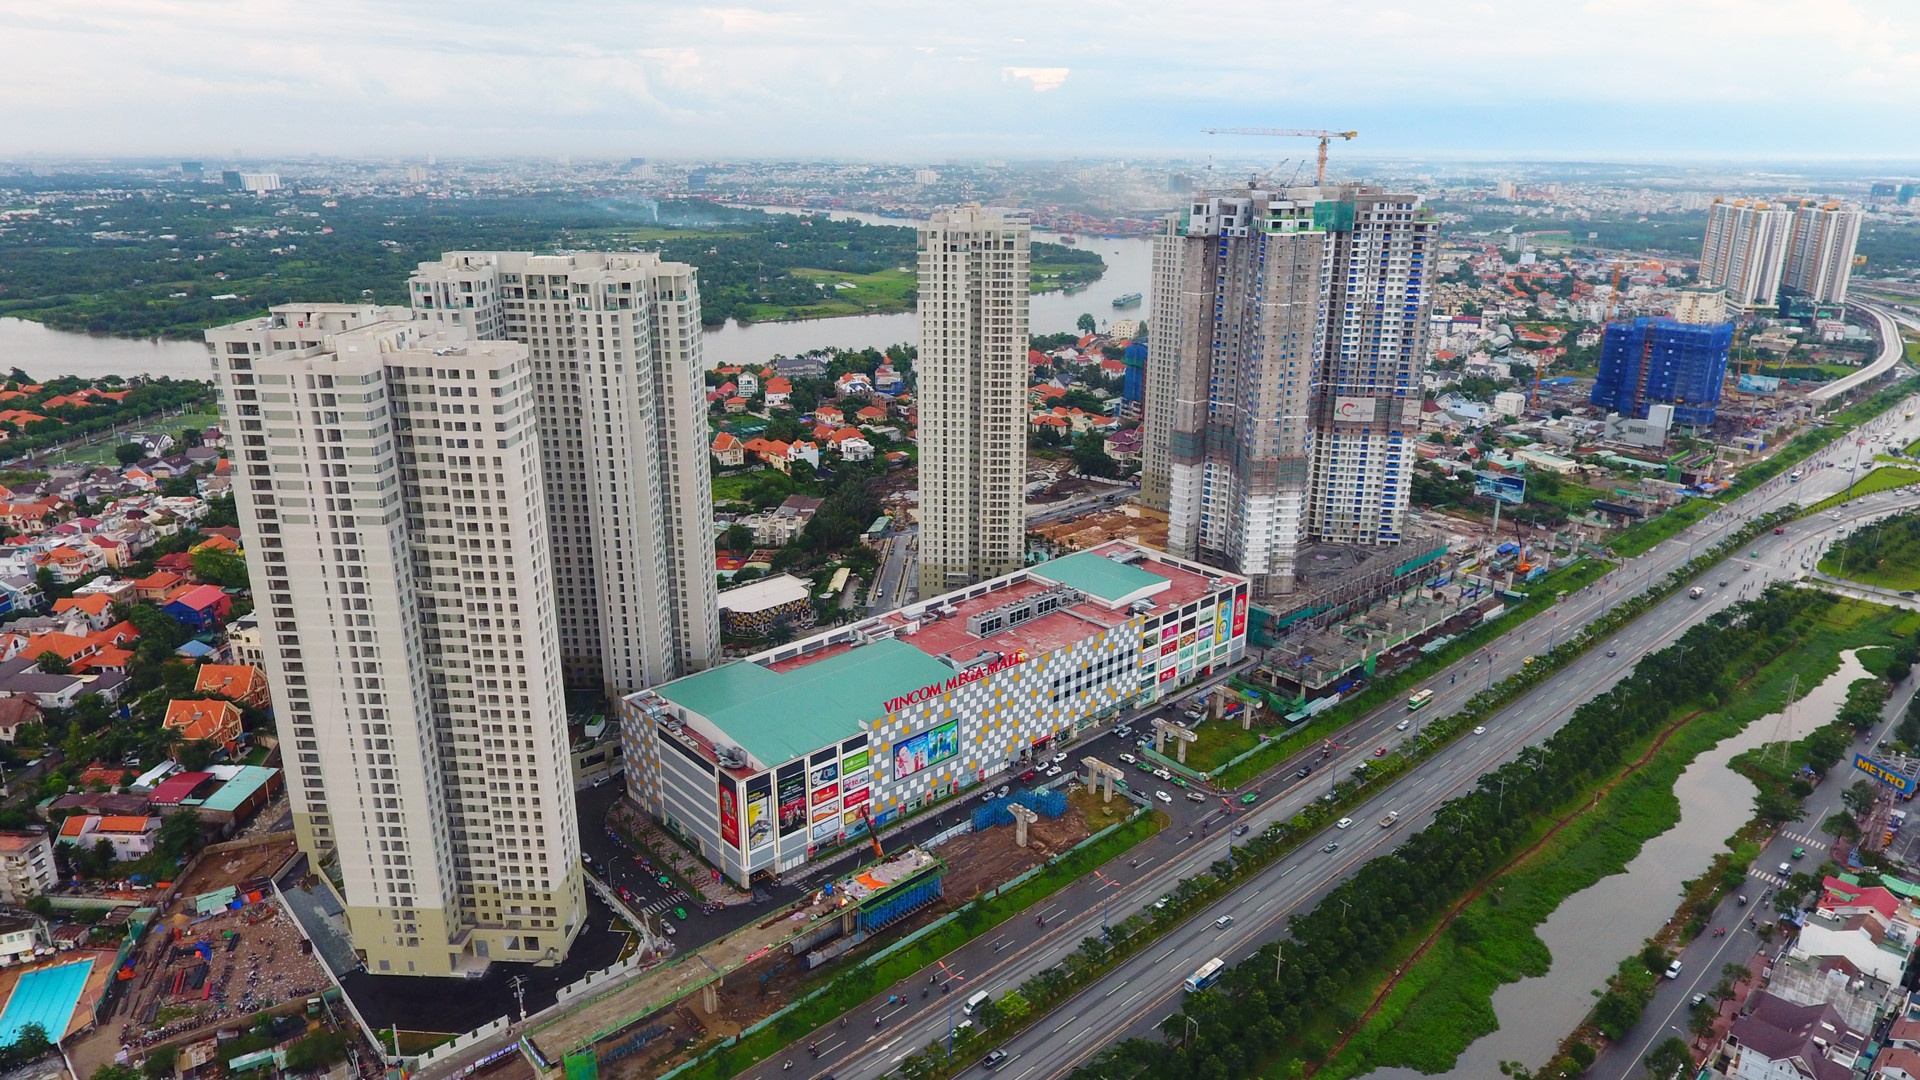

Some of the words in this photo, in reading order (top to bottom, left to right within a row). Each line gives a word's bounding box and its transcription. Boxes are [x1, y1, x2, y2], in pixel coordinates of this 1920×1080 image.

[883, 682, 943, 713] VINCOM
[945, 667, 985, 692] MEGA
[986, 651, 1025, 675] MALL
[1857, 758, 1906, 790] METRO
